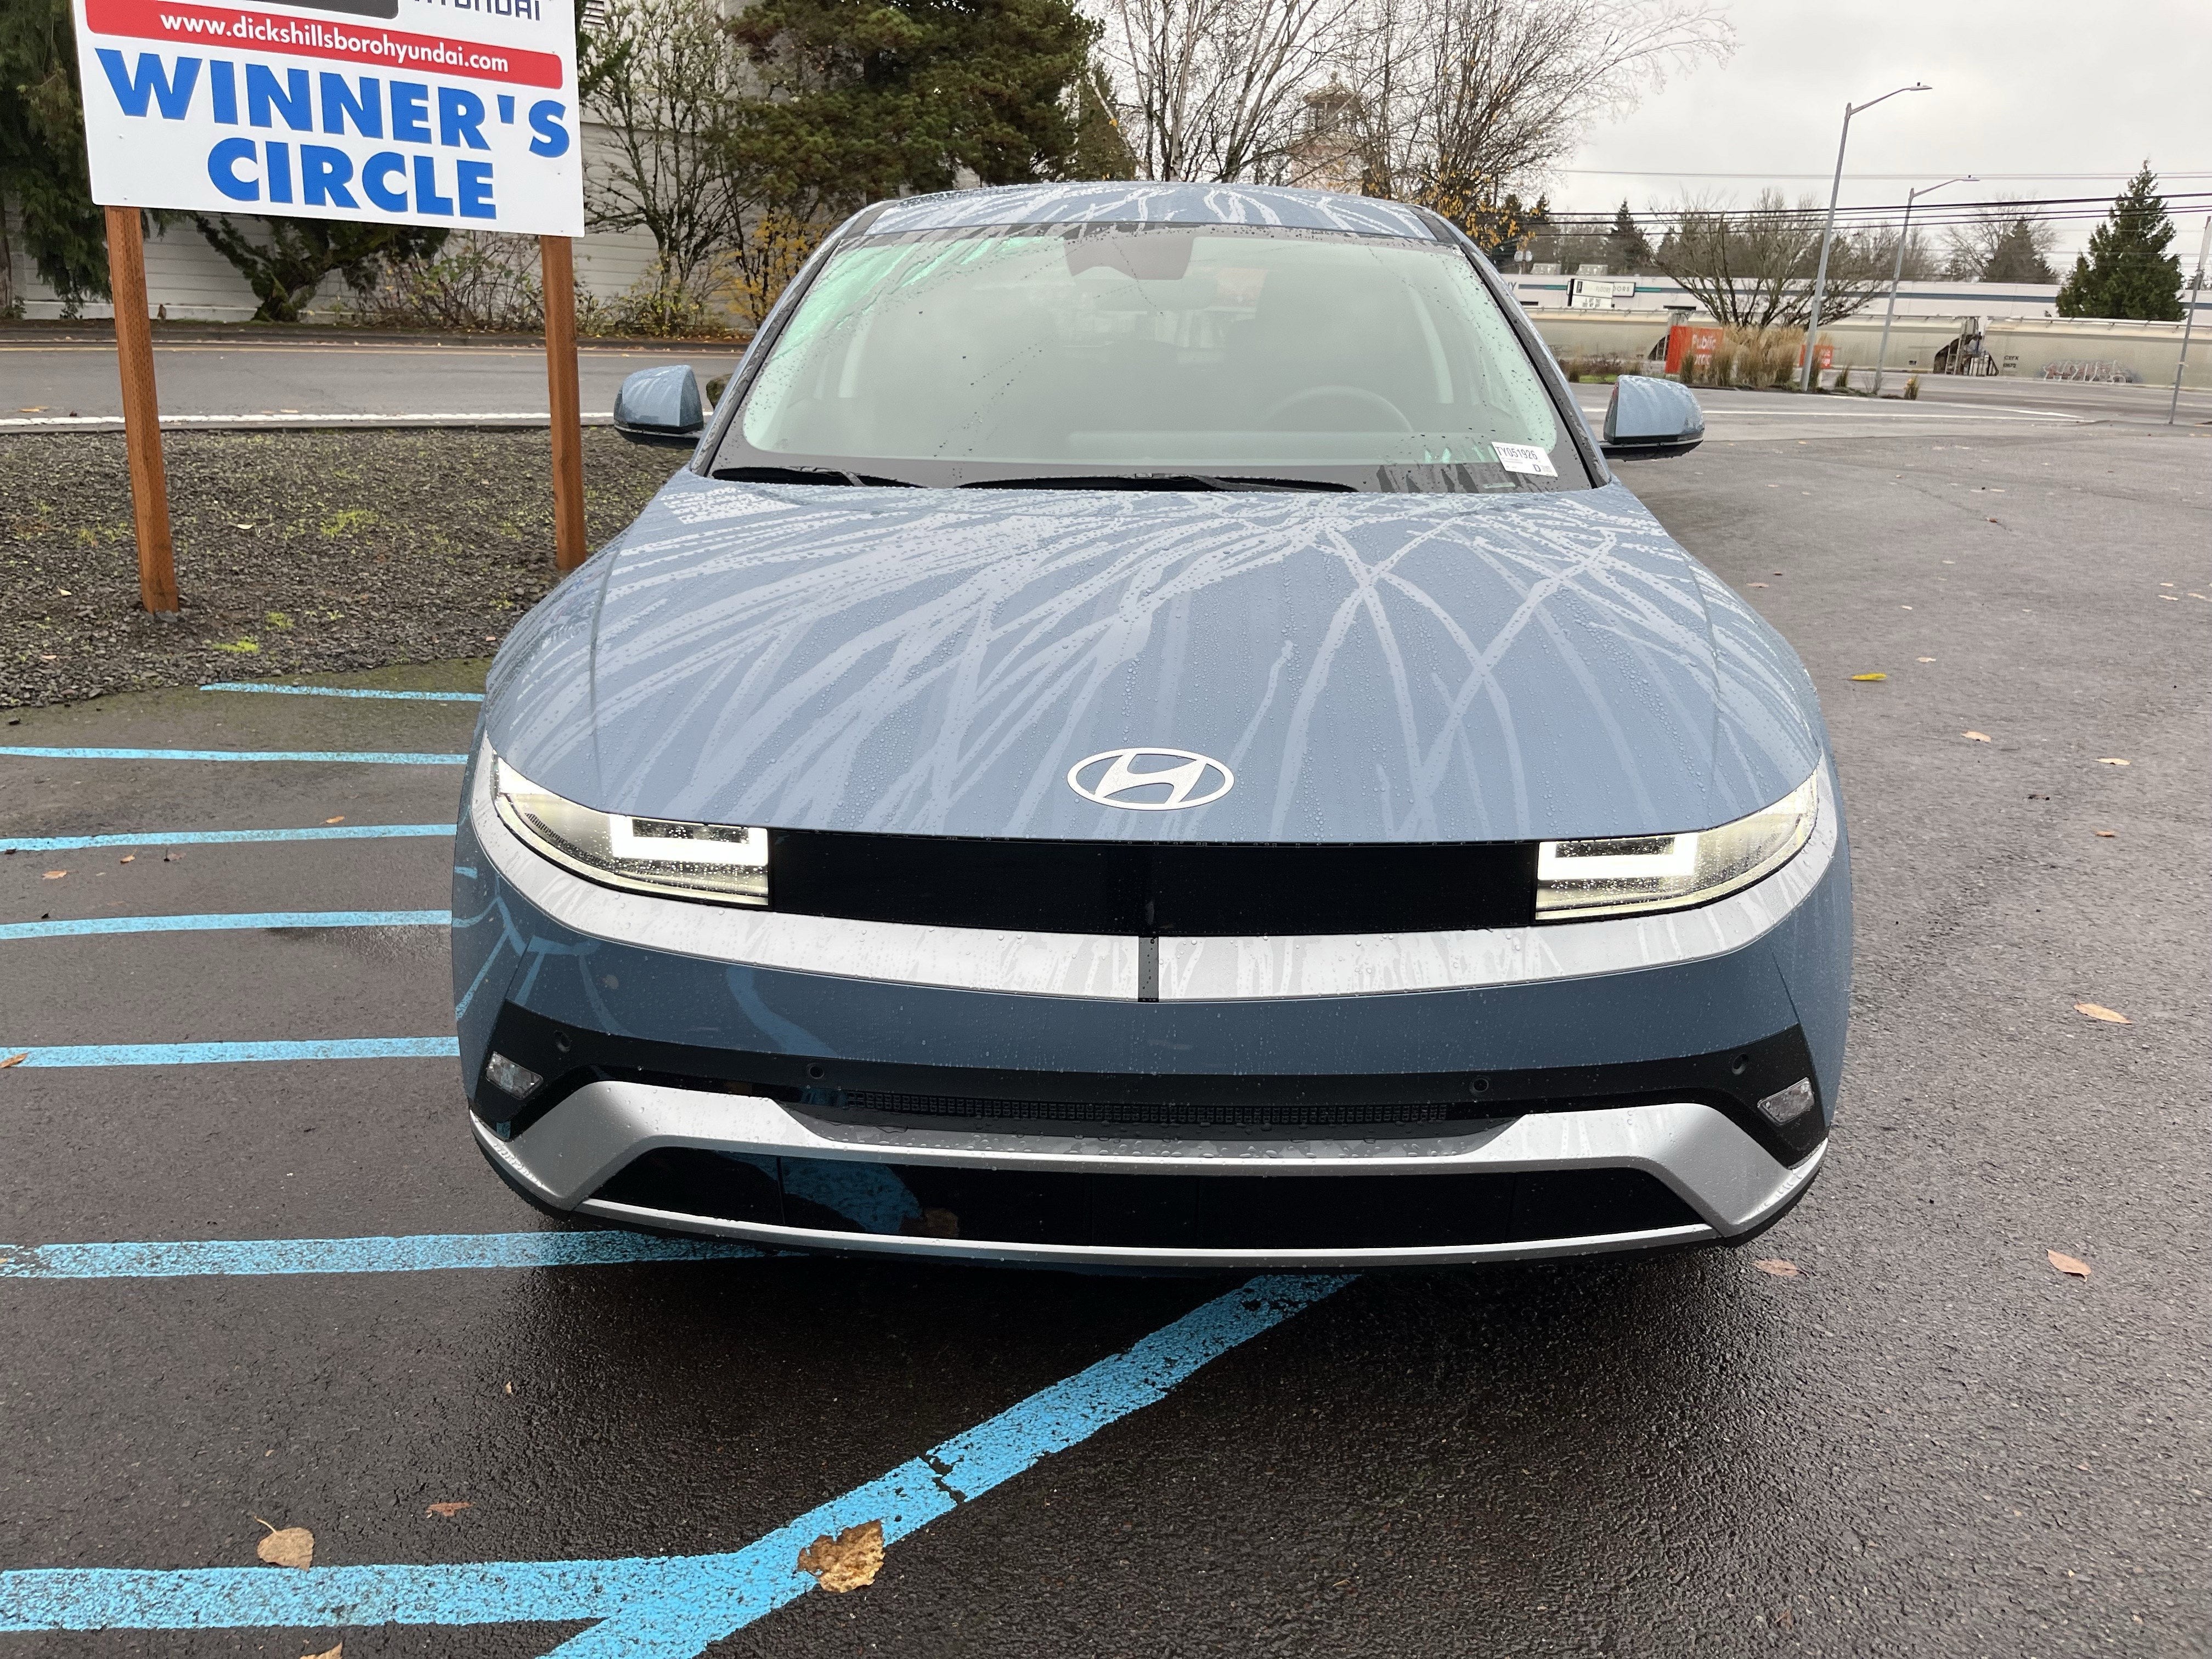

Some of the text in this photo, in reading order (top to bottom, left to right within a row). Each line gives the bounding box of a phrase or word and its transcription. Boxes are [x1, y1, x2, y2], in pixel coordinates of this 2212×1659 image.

[160, 14, 509, 72] www.dickshillsborohyundai.com
[95, 48, 569, 158] WINNER'S
[208, 137, 496, 219] CIRCLE
